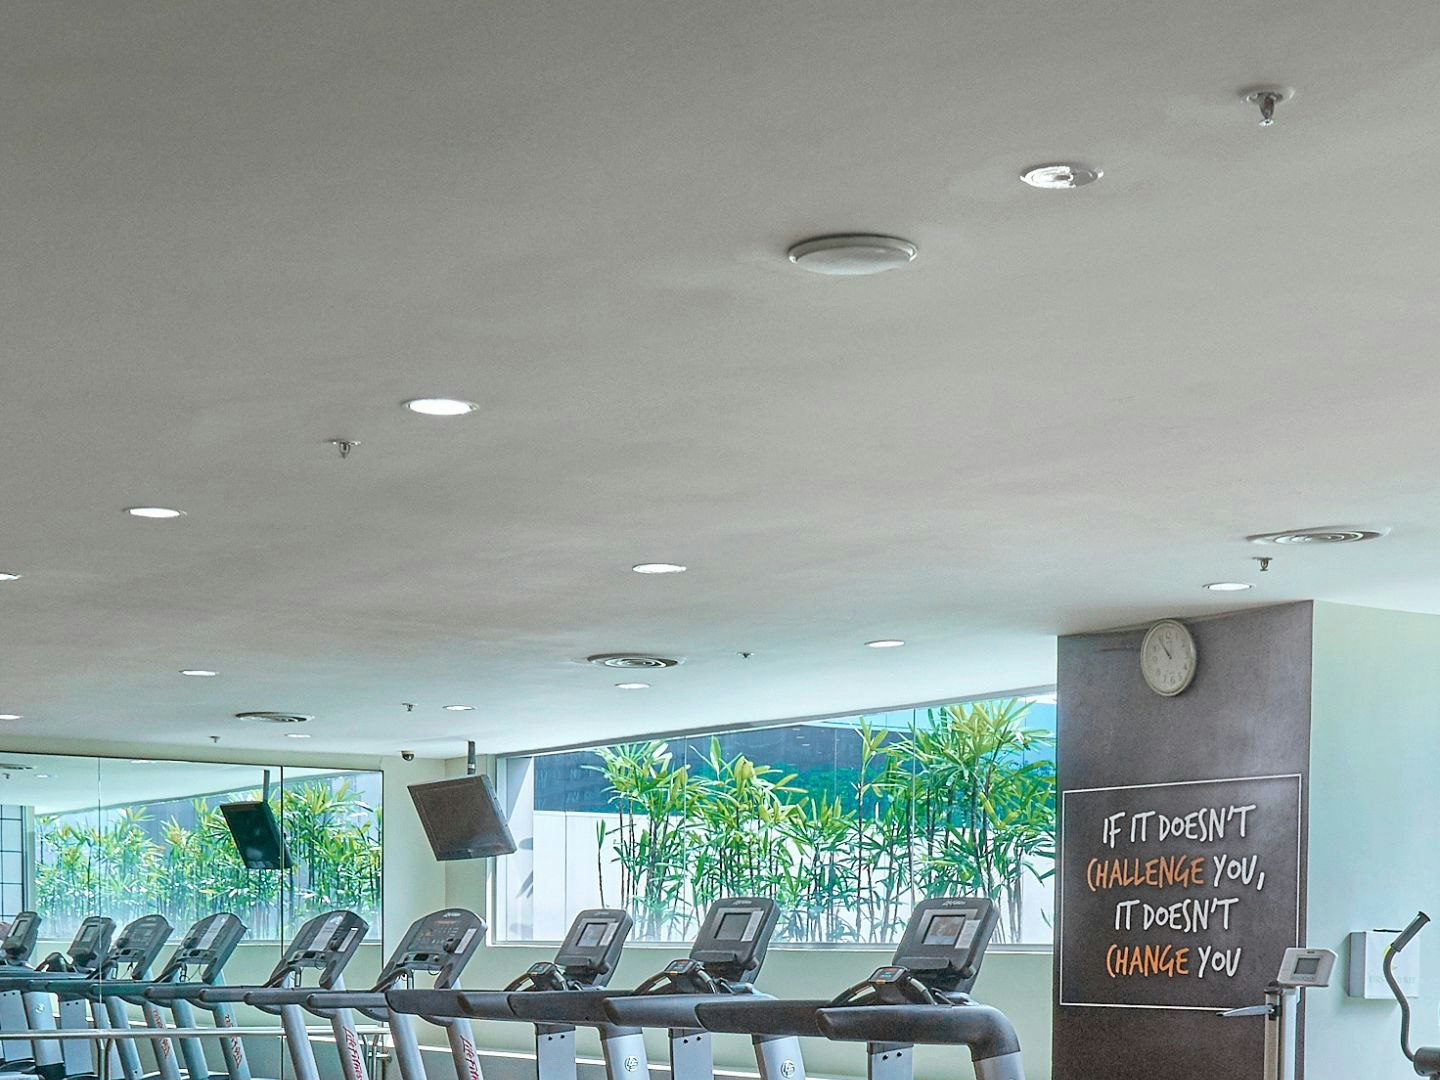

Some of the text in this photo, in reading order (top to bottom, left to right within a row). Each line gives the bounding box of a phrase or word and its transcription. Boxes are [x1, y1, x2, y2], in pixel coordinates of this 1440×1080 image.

[1102, 804, 1257, 849] IF IT DOESN'T
[1086, 853, 1266, 892] CHALLENGE YOU,
[1114, 897, 1240, 933] IT DOESN'T
[1105, 943, 1242, 979] CHANGE YOU
